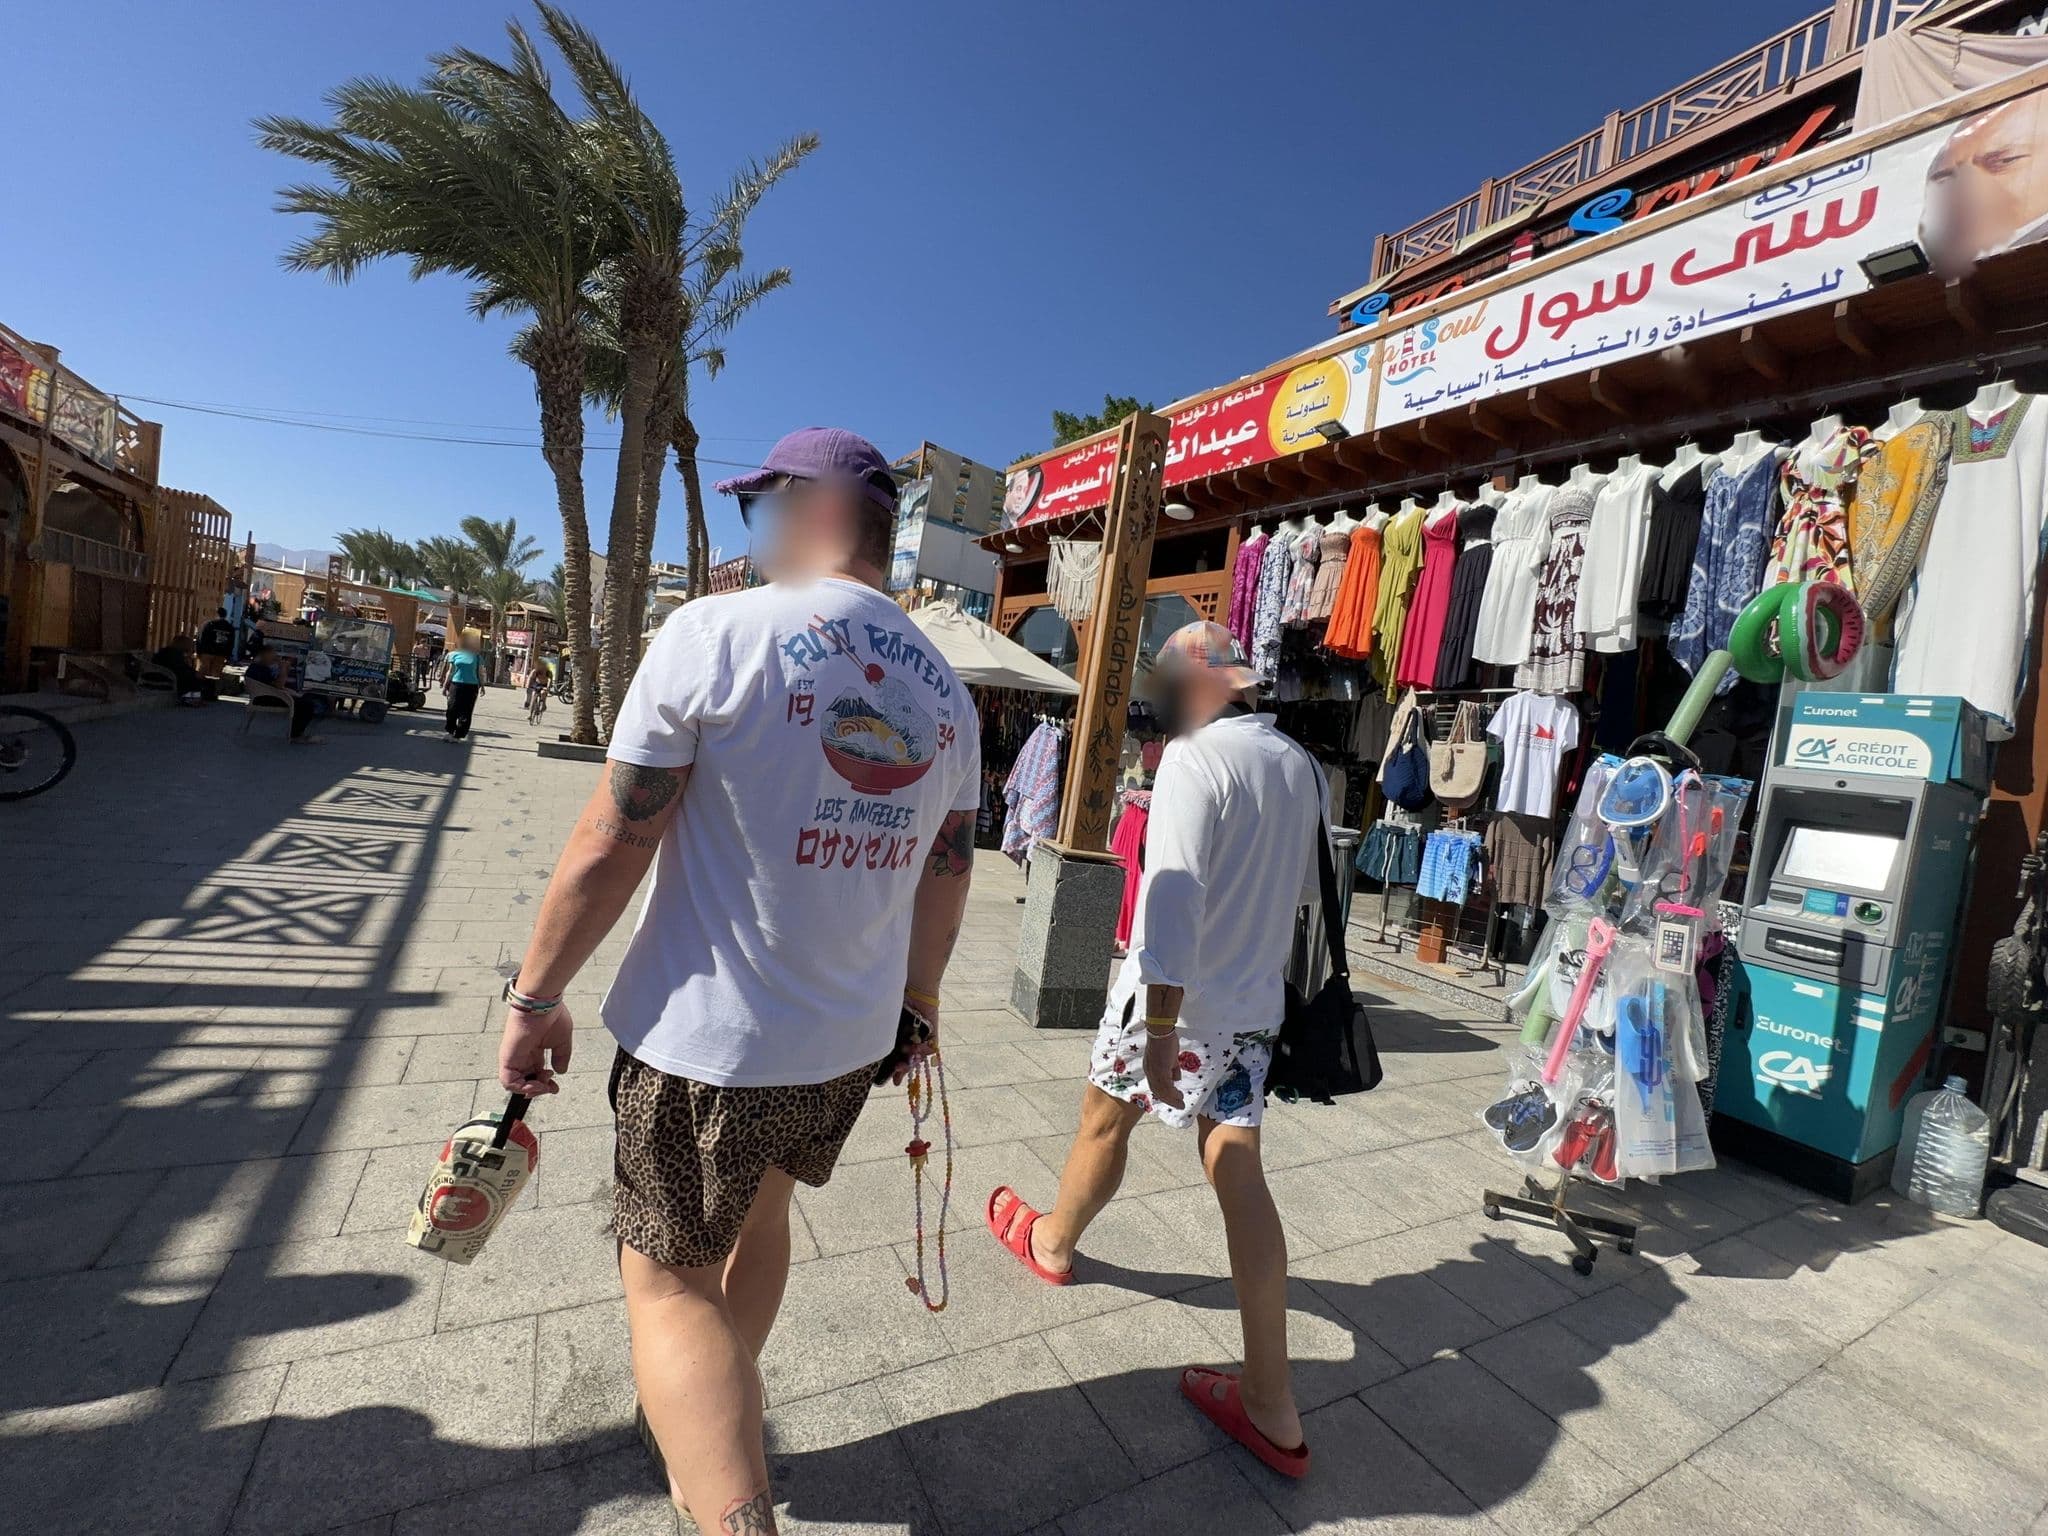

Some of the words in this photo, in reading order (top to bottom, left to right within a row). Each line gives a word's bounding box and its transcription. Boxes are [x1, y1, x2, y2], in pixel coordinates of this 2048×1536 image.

[1484, 262, 1654, 360] سول
[1663, 267, 1845, 342] للفنادق
[1419, 299, 1489, 351] Soul
[1387, 349, 1437, 377] HOTEL
[1286, 395, 1330, 419] للدولة
[1403, 369, 1490, 411] السياحية
[780, 618, 856, 672] FUJI
[1104, 626, 1131, 707] dahab
[787, 693, 815, 727] 19
[1803, 706, 1858, 717] Euronet
[1834, 753, 1919, 769] AGRICOLE
[1847, 742, 1909, 755] CRÉDIT
[814, 797, 846, 823] LOS
[849, 798, 915, 830] ANGELES
[796, 827, 918, 870] ロサンゼルス
[1756, 1015, 1843, 1053] Euronet
